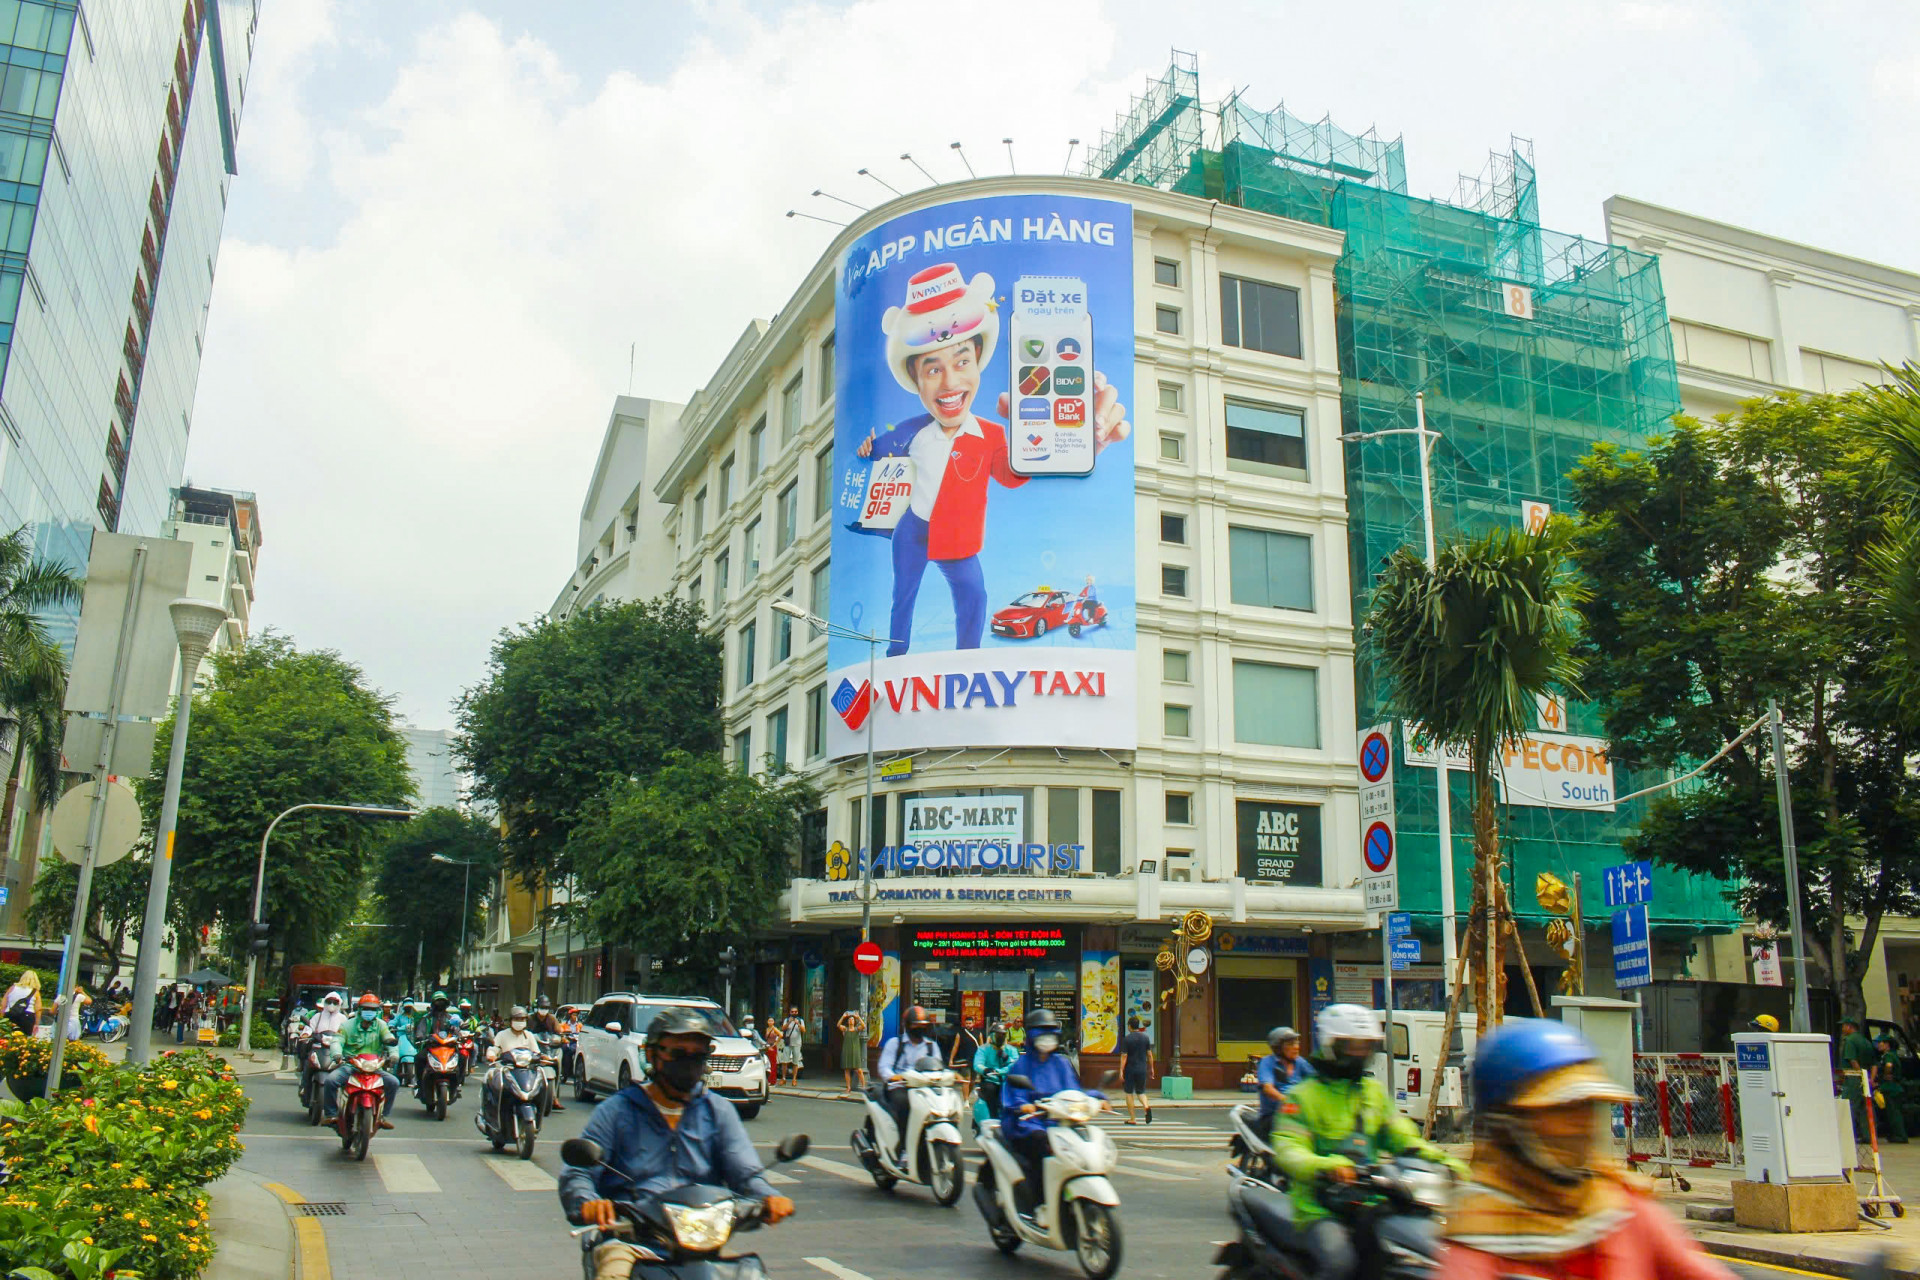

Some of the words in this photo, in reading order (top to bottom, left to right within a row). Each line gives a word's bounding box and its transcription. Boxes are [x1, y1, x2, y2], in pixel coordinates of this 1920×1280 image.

[866, 235, 915, 275] APP
[923, 216, 1012, 253] NGÂN
[1023, 212, 1115, 246] HÀNG
[911, 283, 942, 300] VNPAY
[943, 278, 958, 289] TAXI
[1021, 289, 1056, 306] Đặt
[1061, 293, 1082, 303] xe
[1510, 287, 1526, 315] 8
[1027, 307, 1052, 316] ngay
[1056, 377, 1075, 386] BIDV
[1058, 403, 1075, 413] HD
[1058, 412, 1080, 421] Bank
[844, 468, 852, 486] Ê
[840, 487, 848, 506] Ê
[869, 477, 912, 501] Giảm
[864, 496, 892, 520] giá
[1529, 504, 1545, 537] 6
[884, 670, 1028, 714] VNPAY
[1029, 670, 1106, 698] TAXI
[1543, 700, 1559, 729] 4
[1503, 738, 1608, 776] FECON
[1562, 781, 1609, 801] South
[909, 805, 1018, 832] ABC-MART
[1257, 810, 1299, 835] ABC
[1257, 835, 1300, 852] MART
[858, 843, 1085, 871] SAIGONTOURIST
[1257, 858, 1294, 868] GRAND
[1257, 868, 1291, 878] STAGE
[946, 889, 954, 900] &
[958, 888, 1015, 901] SERVICE
[1018, 889, 1072, 901] CENTER
[919, 940, 933, 948] ngày
[952, 940, 971, 948] (Mùng
[976, 939, 989, 948] Tết)
[994, 940, 1009, 948] Trọn
[1010, 940, 1020, 948] gói
